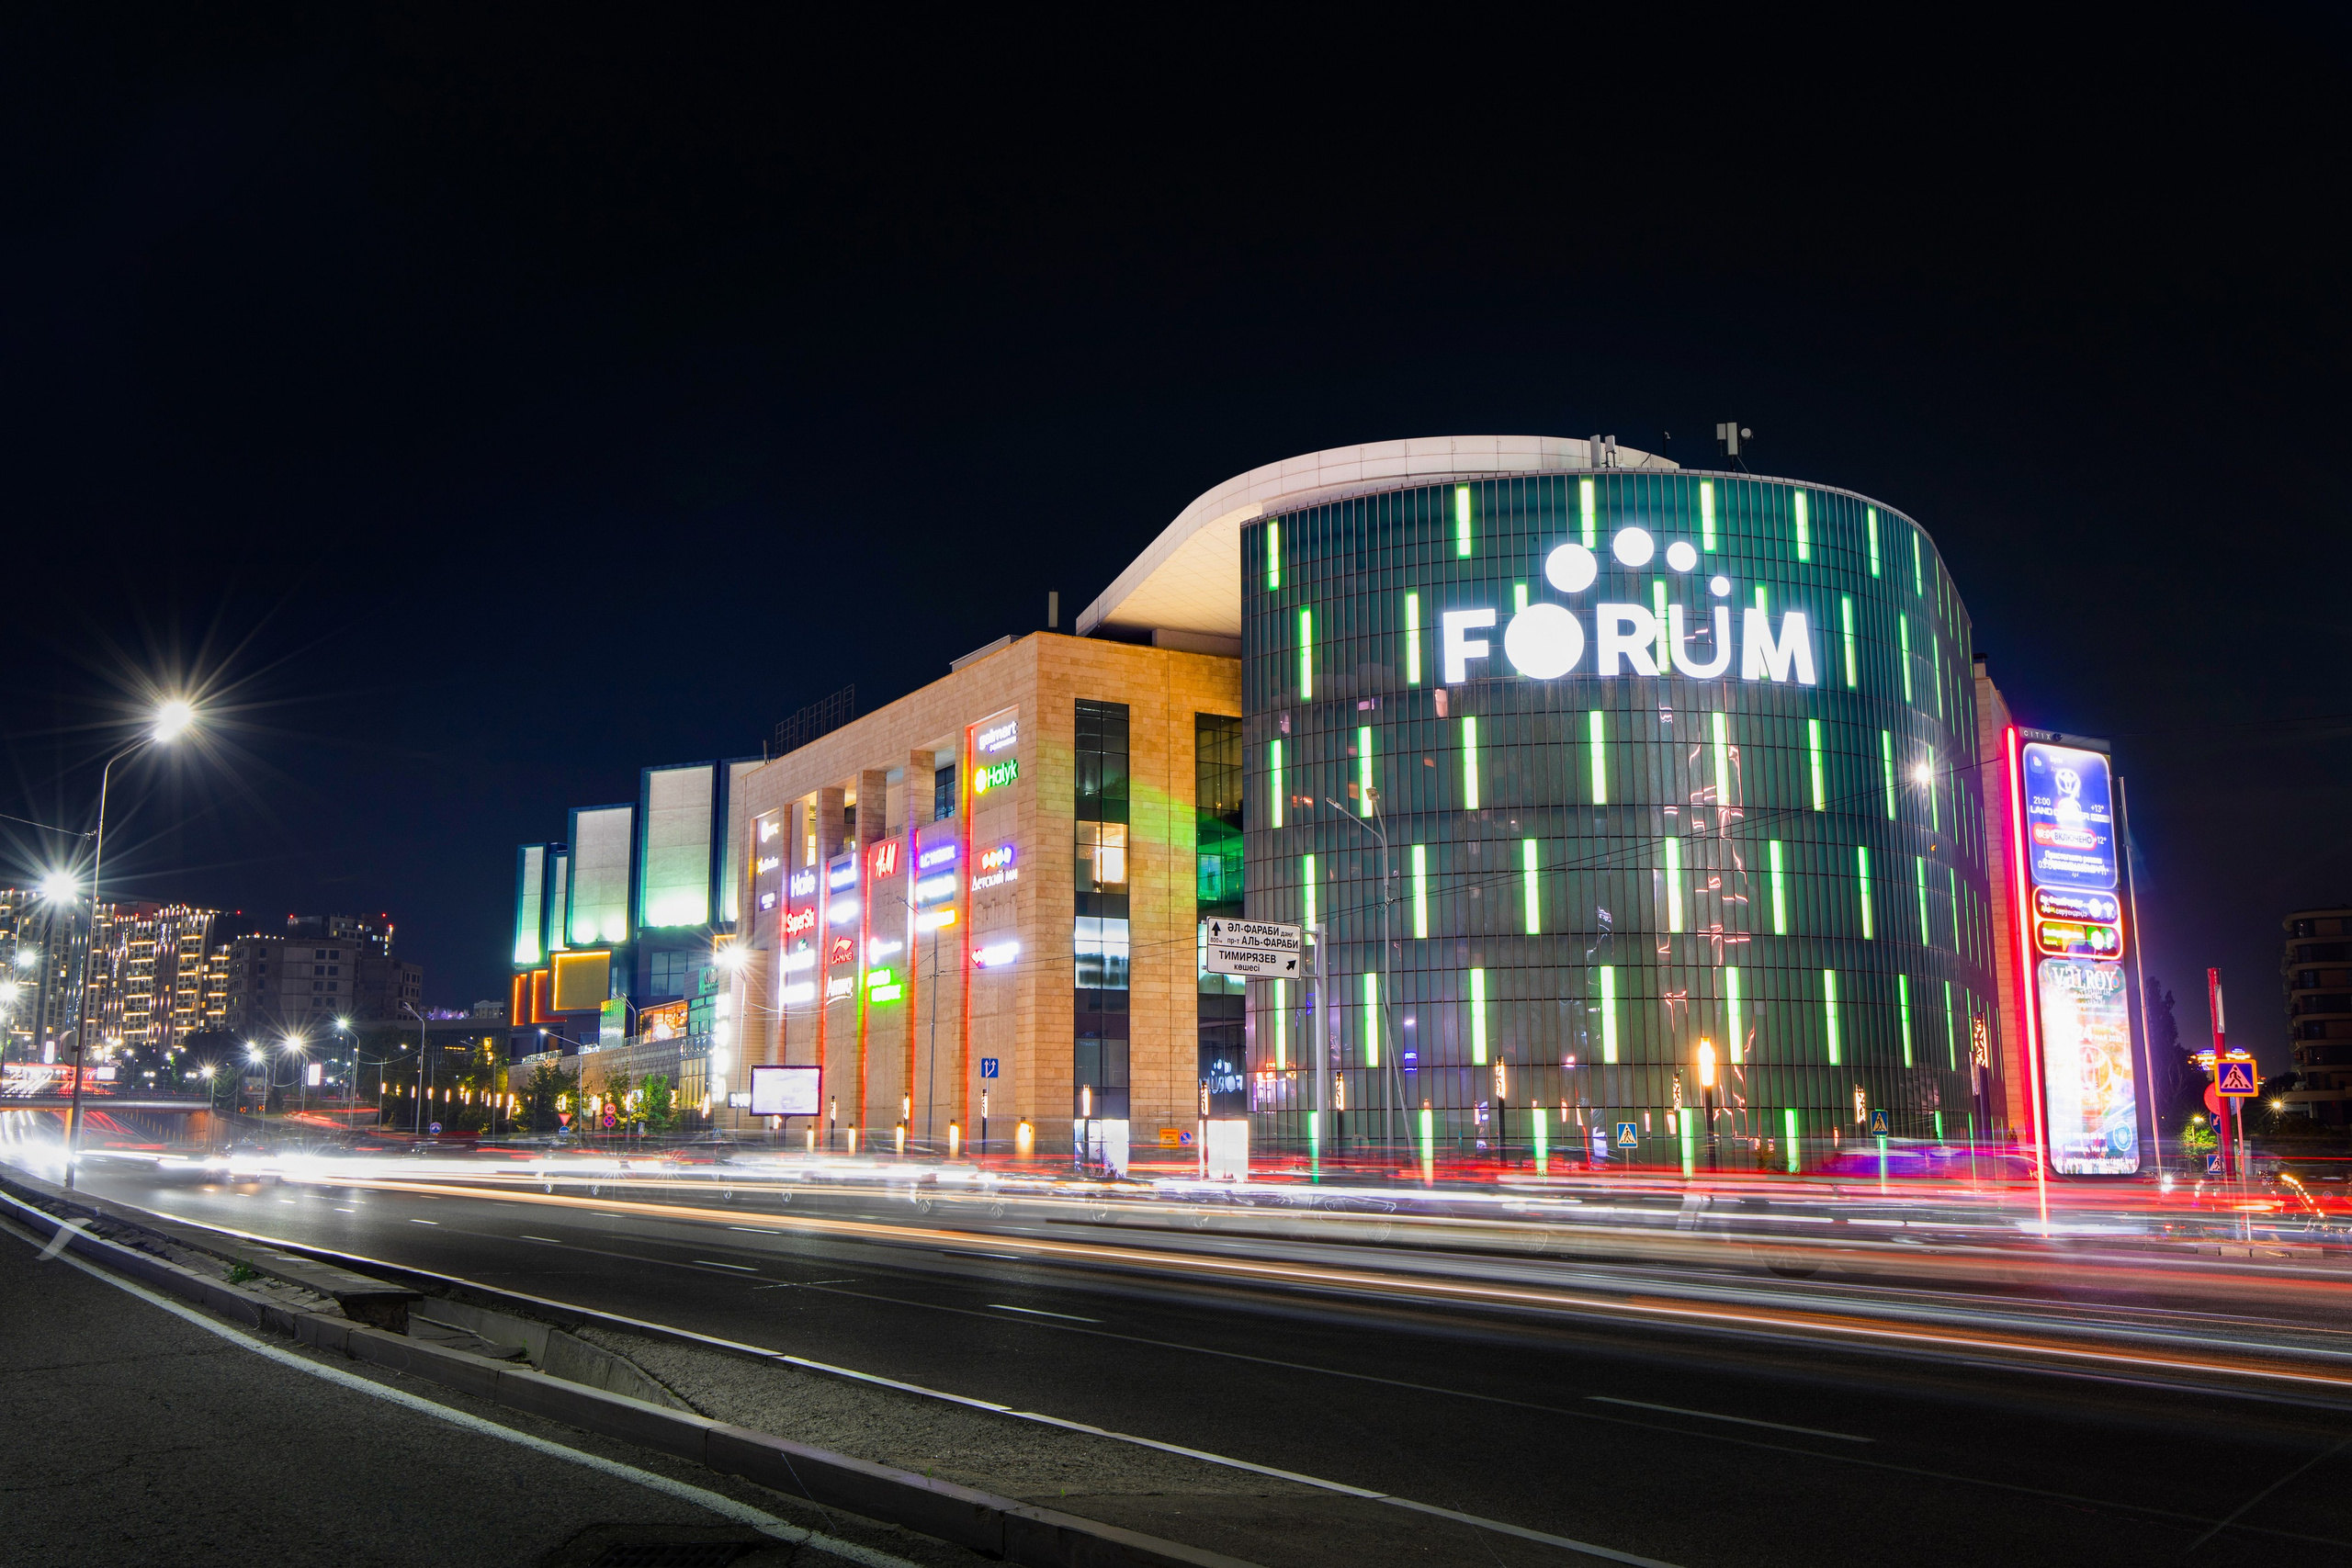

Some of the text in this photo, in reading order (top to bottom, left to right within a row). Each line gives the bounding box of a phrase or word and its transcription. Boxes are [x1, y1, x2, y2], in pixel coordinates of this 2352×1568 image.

[2023, 730, 2052, 740] CITIX
[988, 760, 1018, 787] Halyk
[2033, 796, 2051, 806] 21:00
[2030, 806, 2053, 817] LAND
[2054, 832, 2093, 844] ВКЛЮЧЕНО
[876, 842, 897, 878] H&M
[971, 869, 1004, 892] Детский
[1227, 923, 1280, 936] ӘЛ-ФАРАБИ
[1241, 936, 1298, 949] АЛЬ-ФАРАБИ
[1219, 950, 1277, 964] ТИМИРЯЗЕВ
[1234, 964, 1261, 972] көшесі
